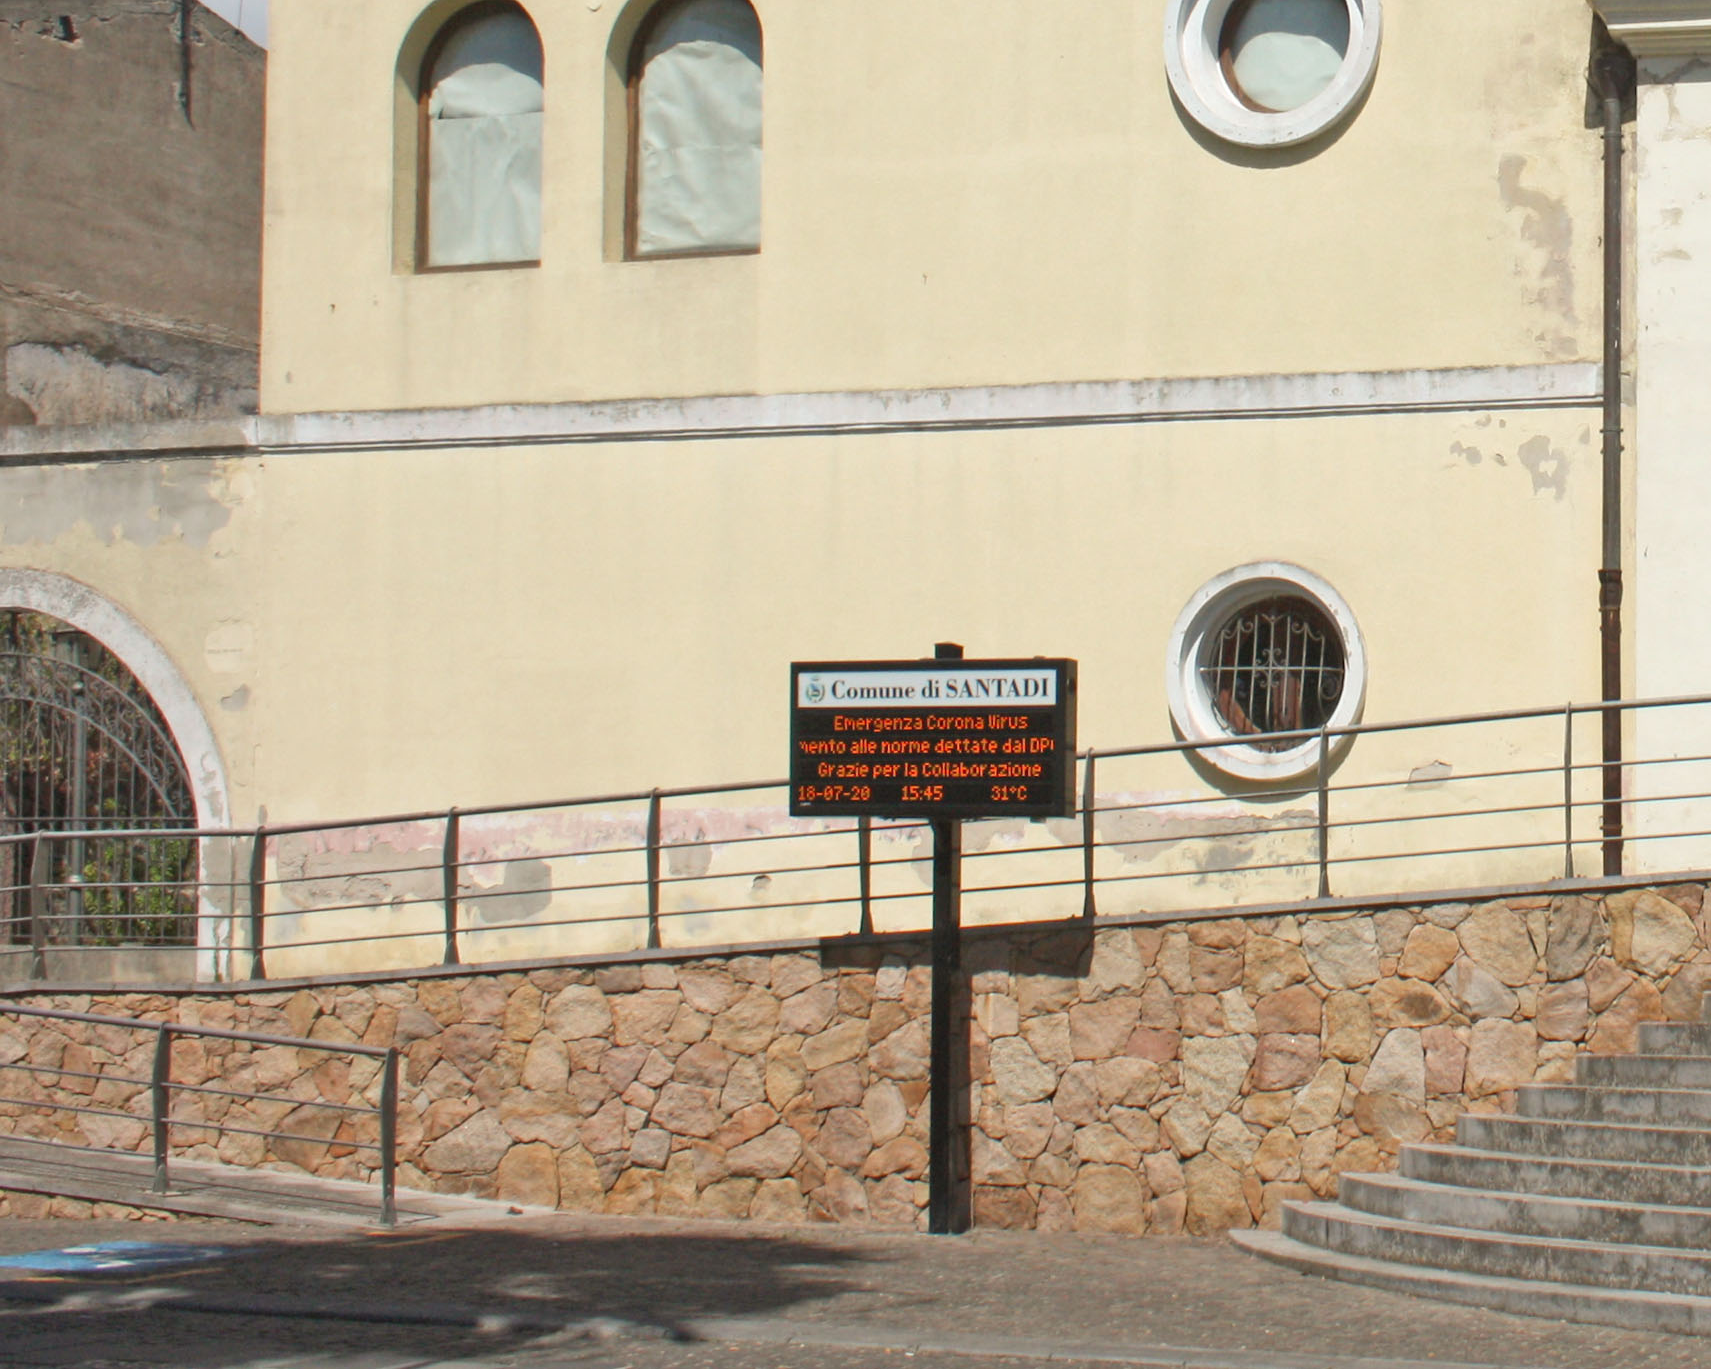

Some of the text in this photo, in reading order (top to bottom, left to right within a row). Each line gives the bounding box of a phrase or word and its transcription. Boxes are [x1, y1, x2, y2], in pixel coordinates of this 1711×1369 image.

[831, 677, 1050, 700] Comune di SANTADI
[833, 714, 1029, 733] Emergenza Corona Virus
[849, 738, 878, 754] alle
[880, 740, 931, 754] norme
[934, 738, 999, 754] dettate
[1001, 737, 1026, 754] dal
[817, 761, 1043, 780] Grazie per la Collaborazione
[798, 784, 1028, 801] 18-07-20 15:45 31°C
